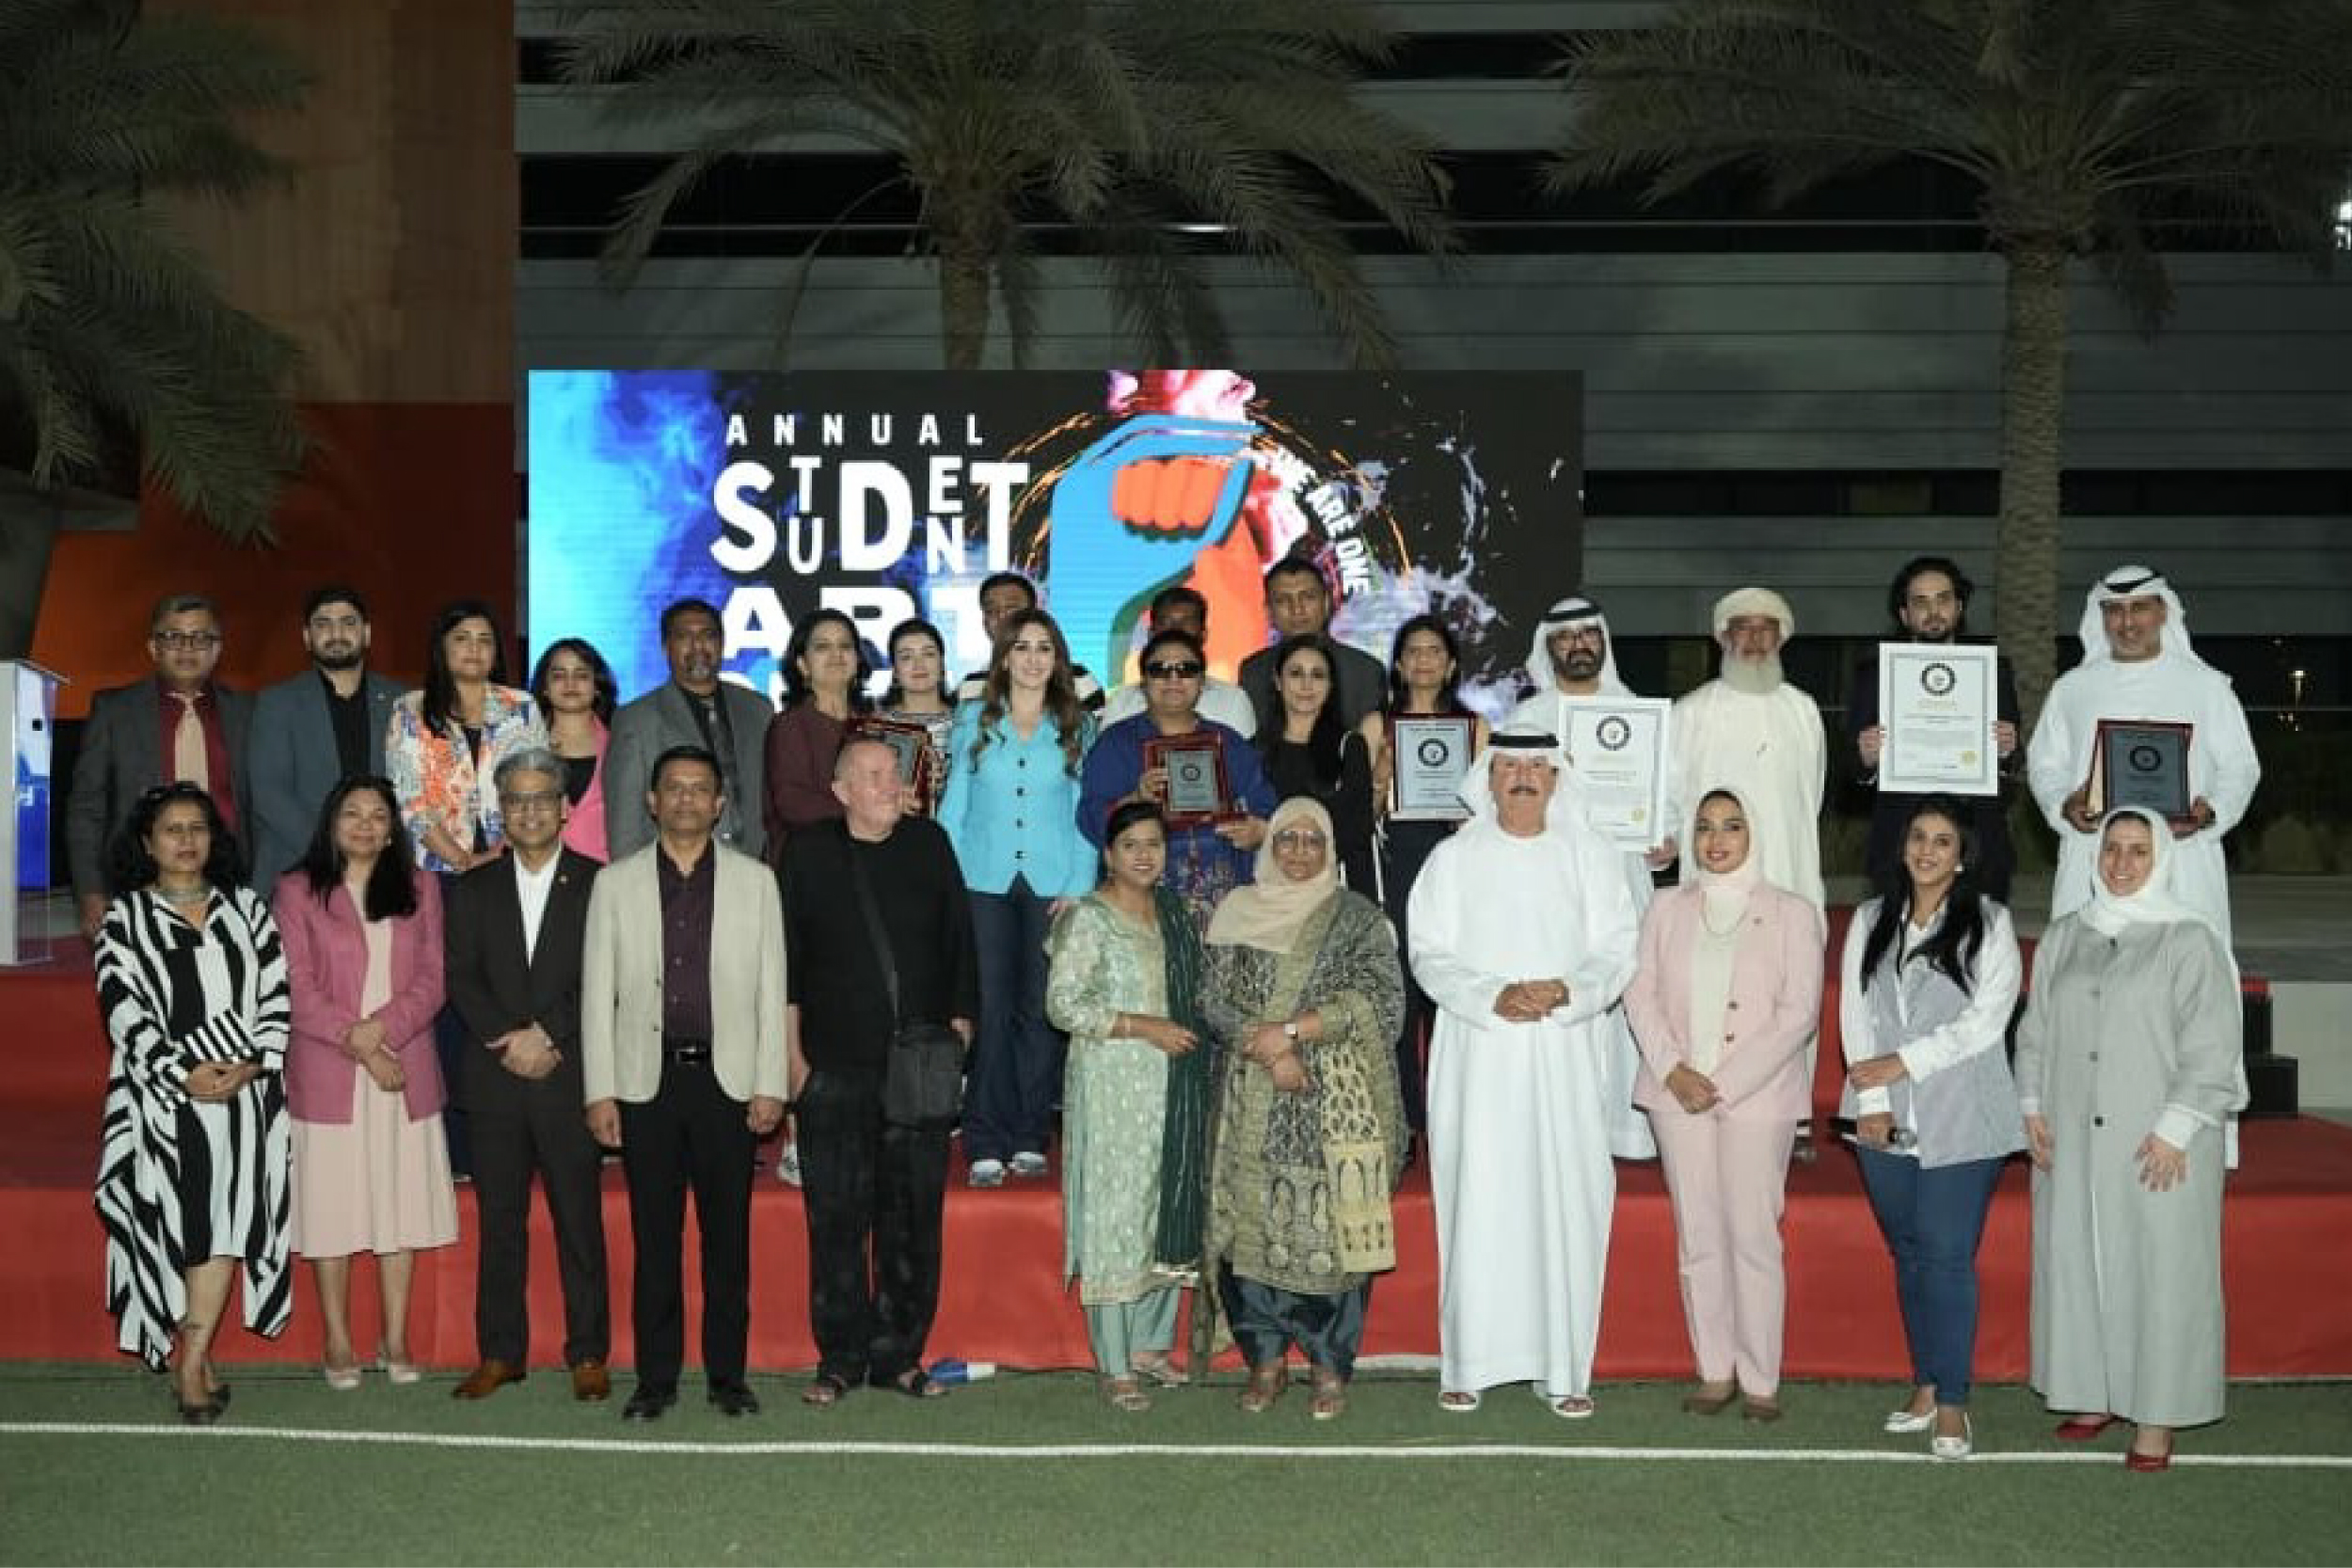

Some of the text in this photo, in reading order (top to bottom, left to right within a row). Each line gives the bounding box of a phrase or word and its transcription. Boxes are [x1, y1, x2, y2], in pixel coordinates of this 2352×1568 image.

[724, 414, 983, 445] ANNUAL
[1306, 484, 1356, 538] ARE
[1335, 537, 1370, 595] ONE
